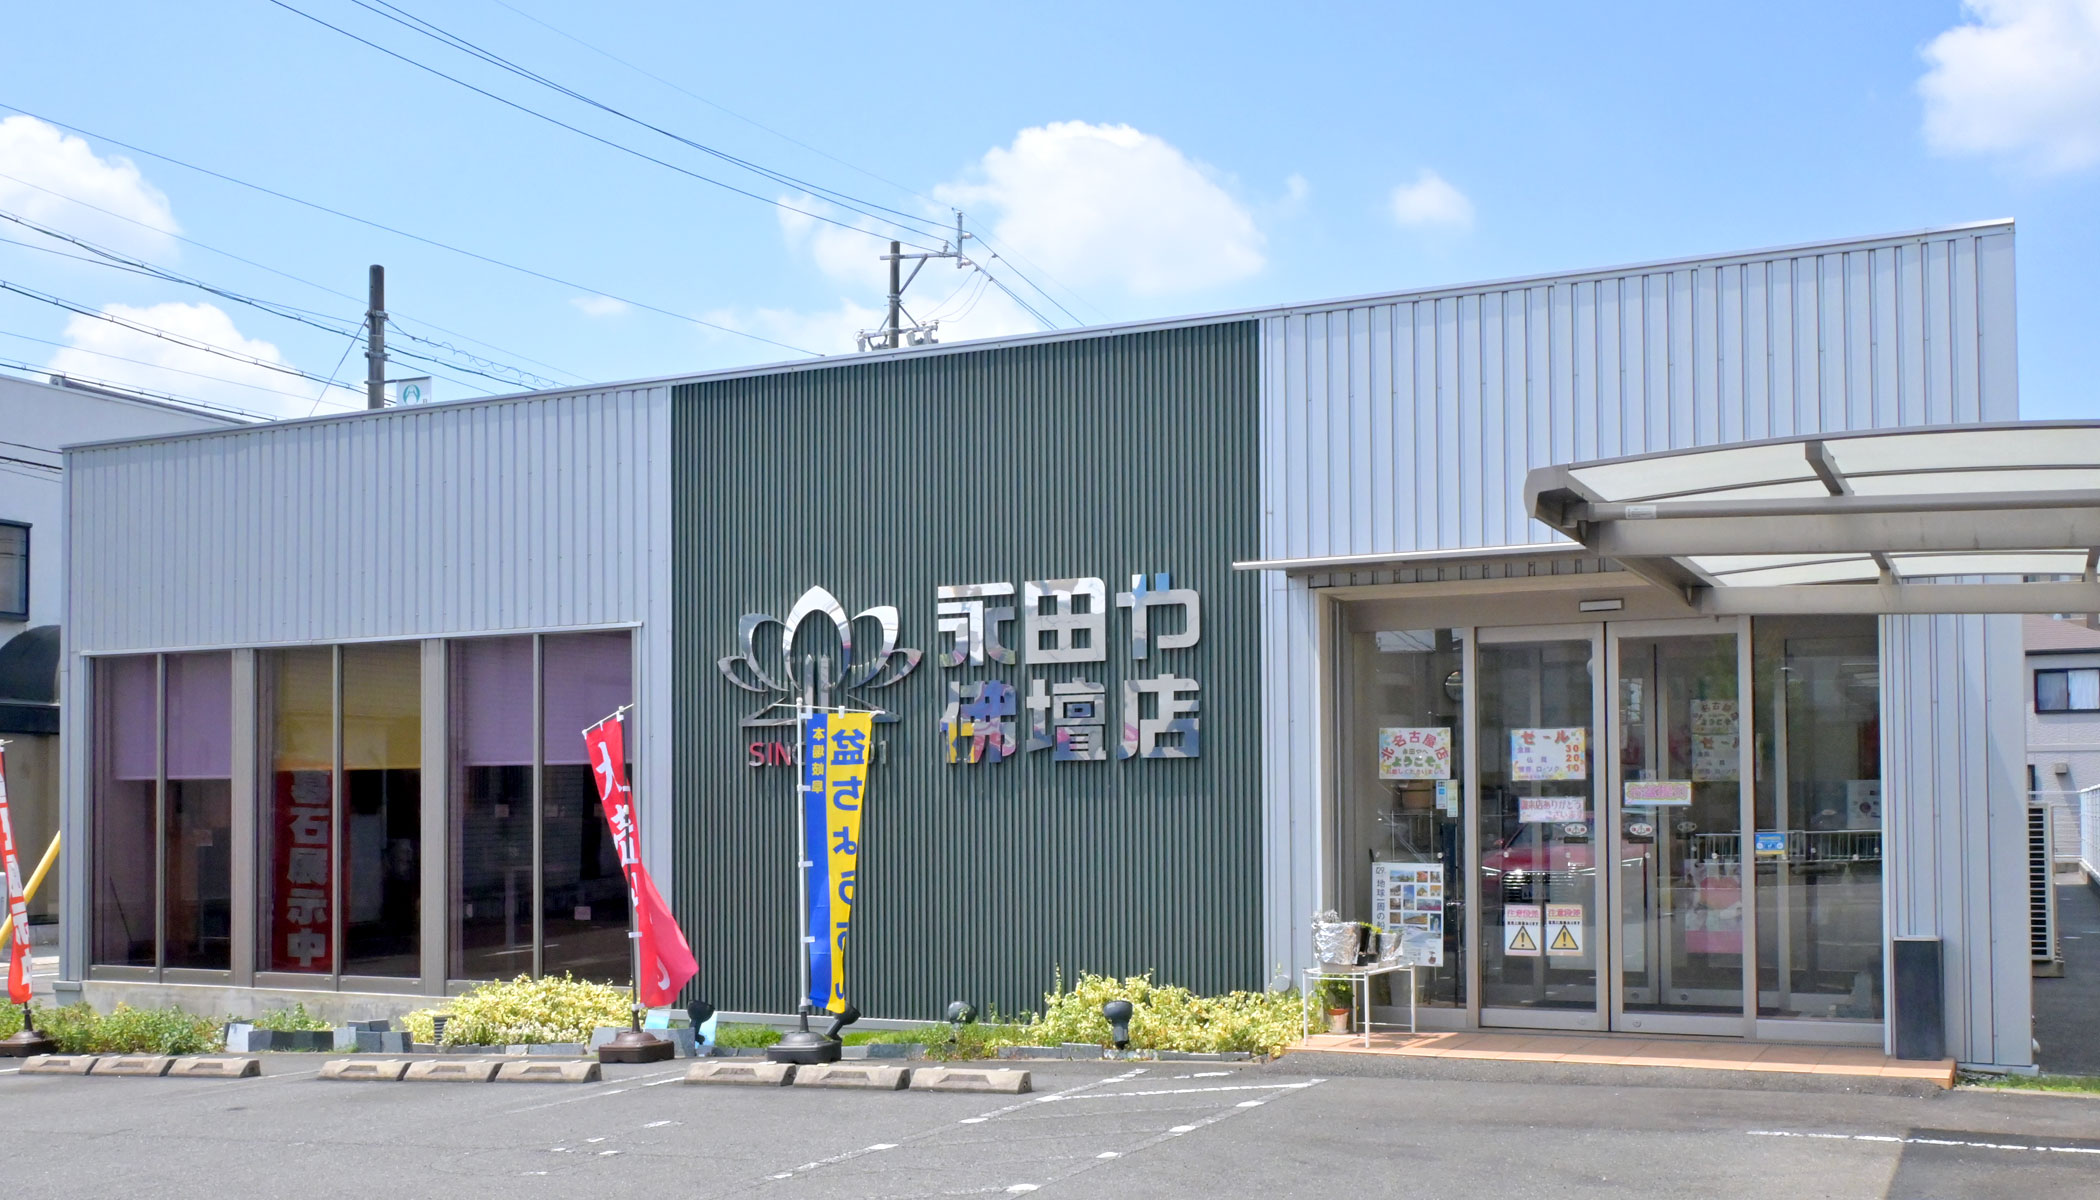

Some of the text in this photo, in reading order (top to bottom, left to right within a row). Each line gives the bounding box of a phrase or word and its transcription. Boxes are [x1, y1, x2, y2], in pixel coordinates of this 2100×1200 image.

[938, 573, 1200, 668] 永田や
[939, 673, 1200, 764] 佛壇店
